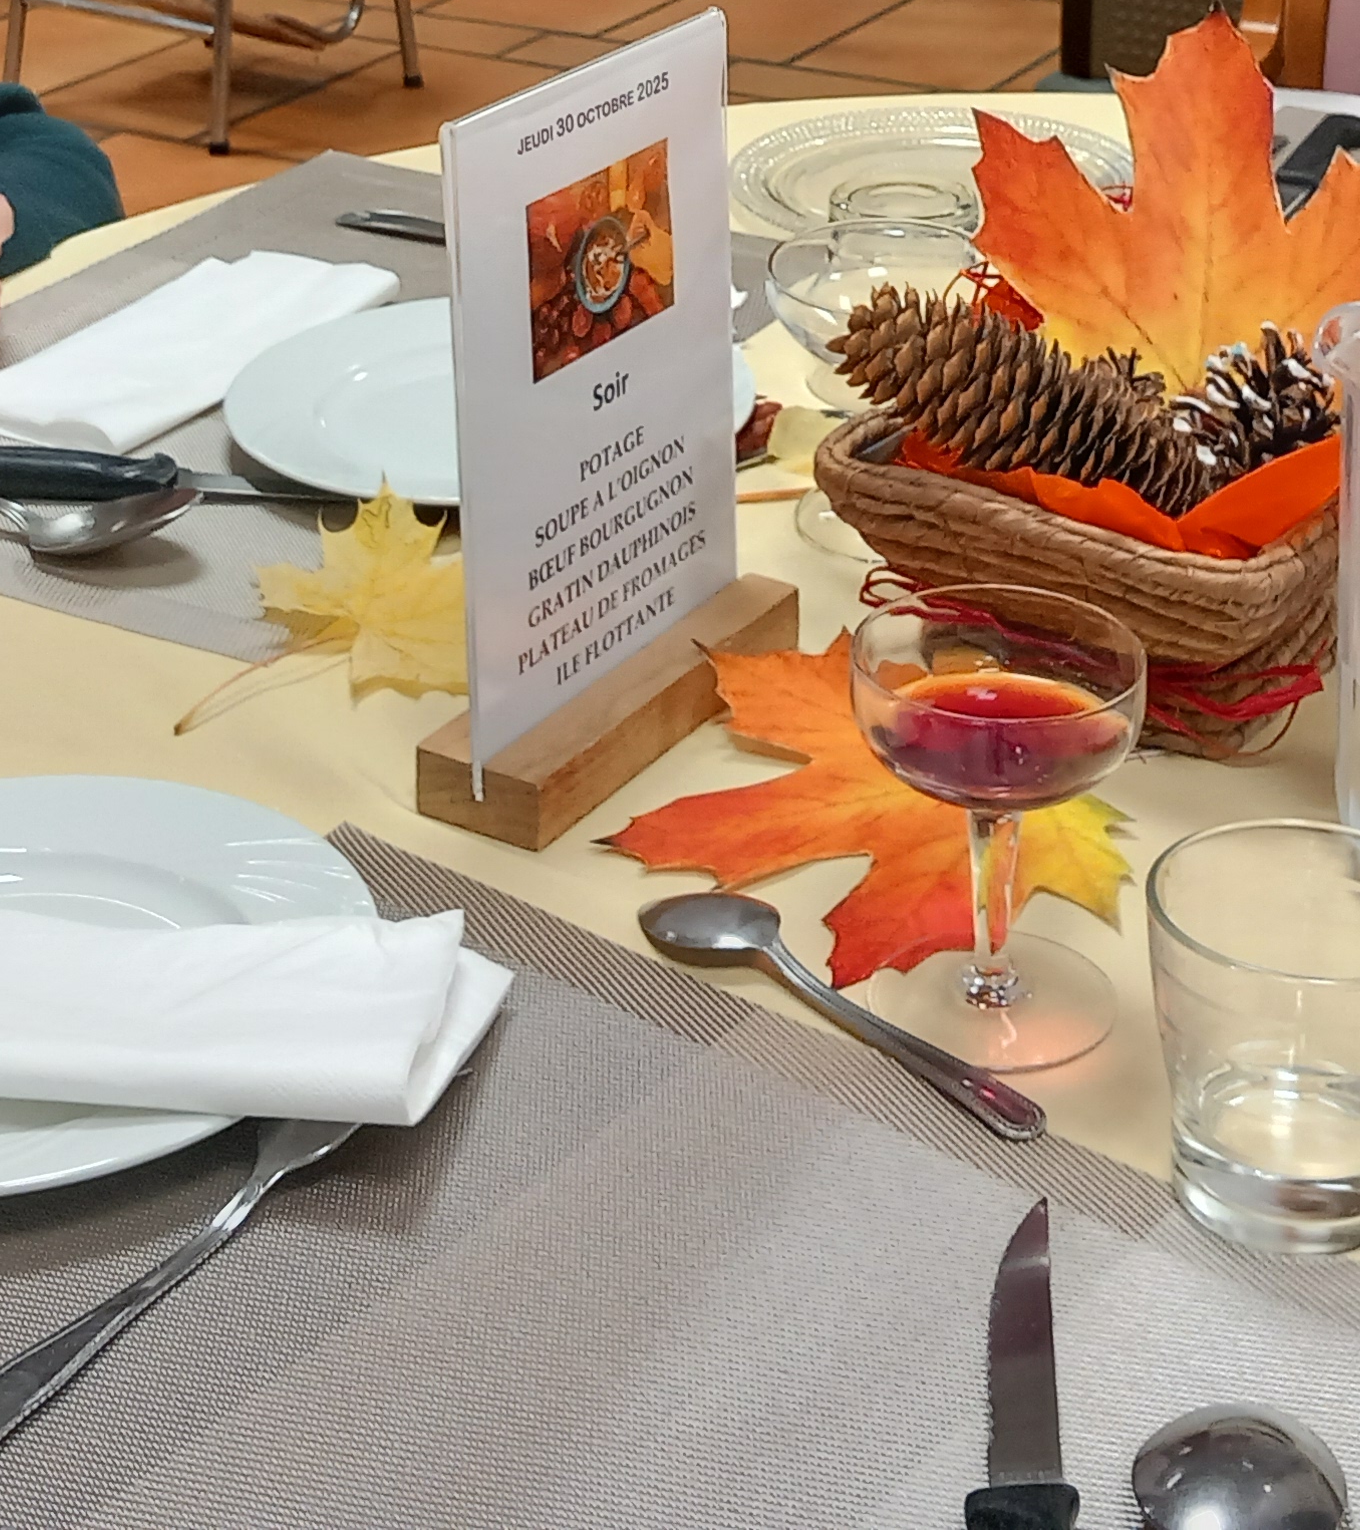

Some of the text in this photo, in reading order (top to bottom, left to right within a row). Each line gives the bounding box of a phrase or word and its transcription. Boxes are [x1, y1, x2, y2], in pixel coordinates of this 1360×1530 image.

[516, 71, 670, 156] JEUDI 30 OCTOBRE 2025
[592, 371, 629, 411] Soir
[534, 435, 685, 549] SOUPE A L'OIGNON
[579, 425, 645, 482] POTAGE
[517, 529, 707, 676] PLATEAU DE FROMAGES
[527, 500, 697, 628] GRATIN DAUPHINOIS
[527, 544, 576, 591] BŒUF
[555, 586, 676, 686] ILE FLOTTANTE
